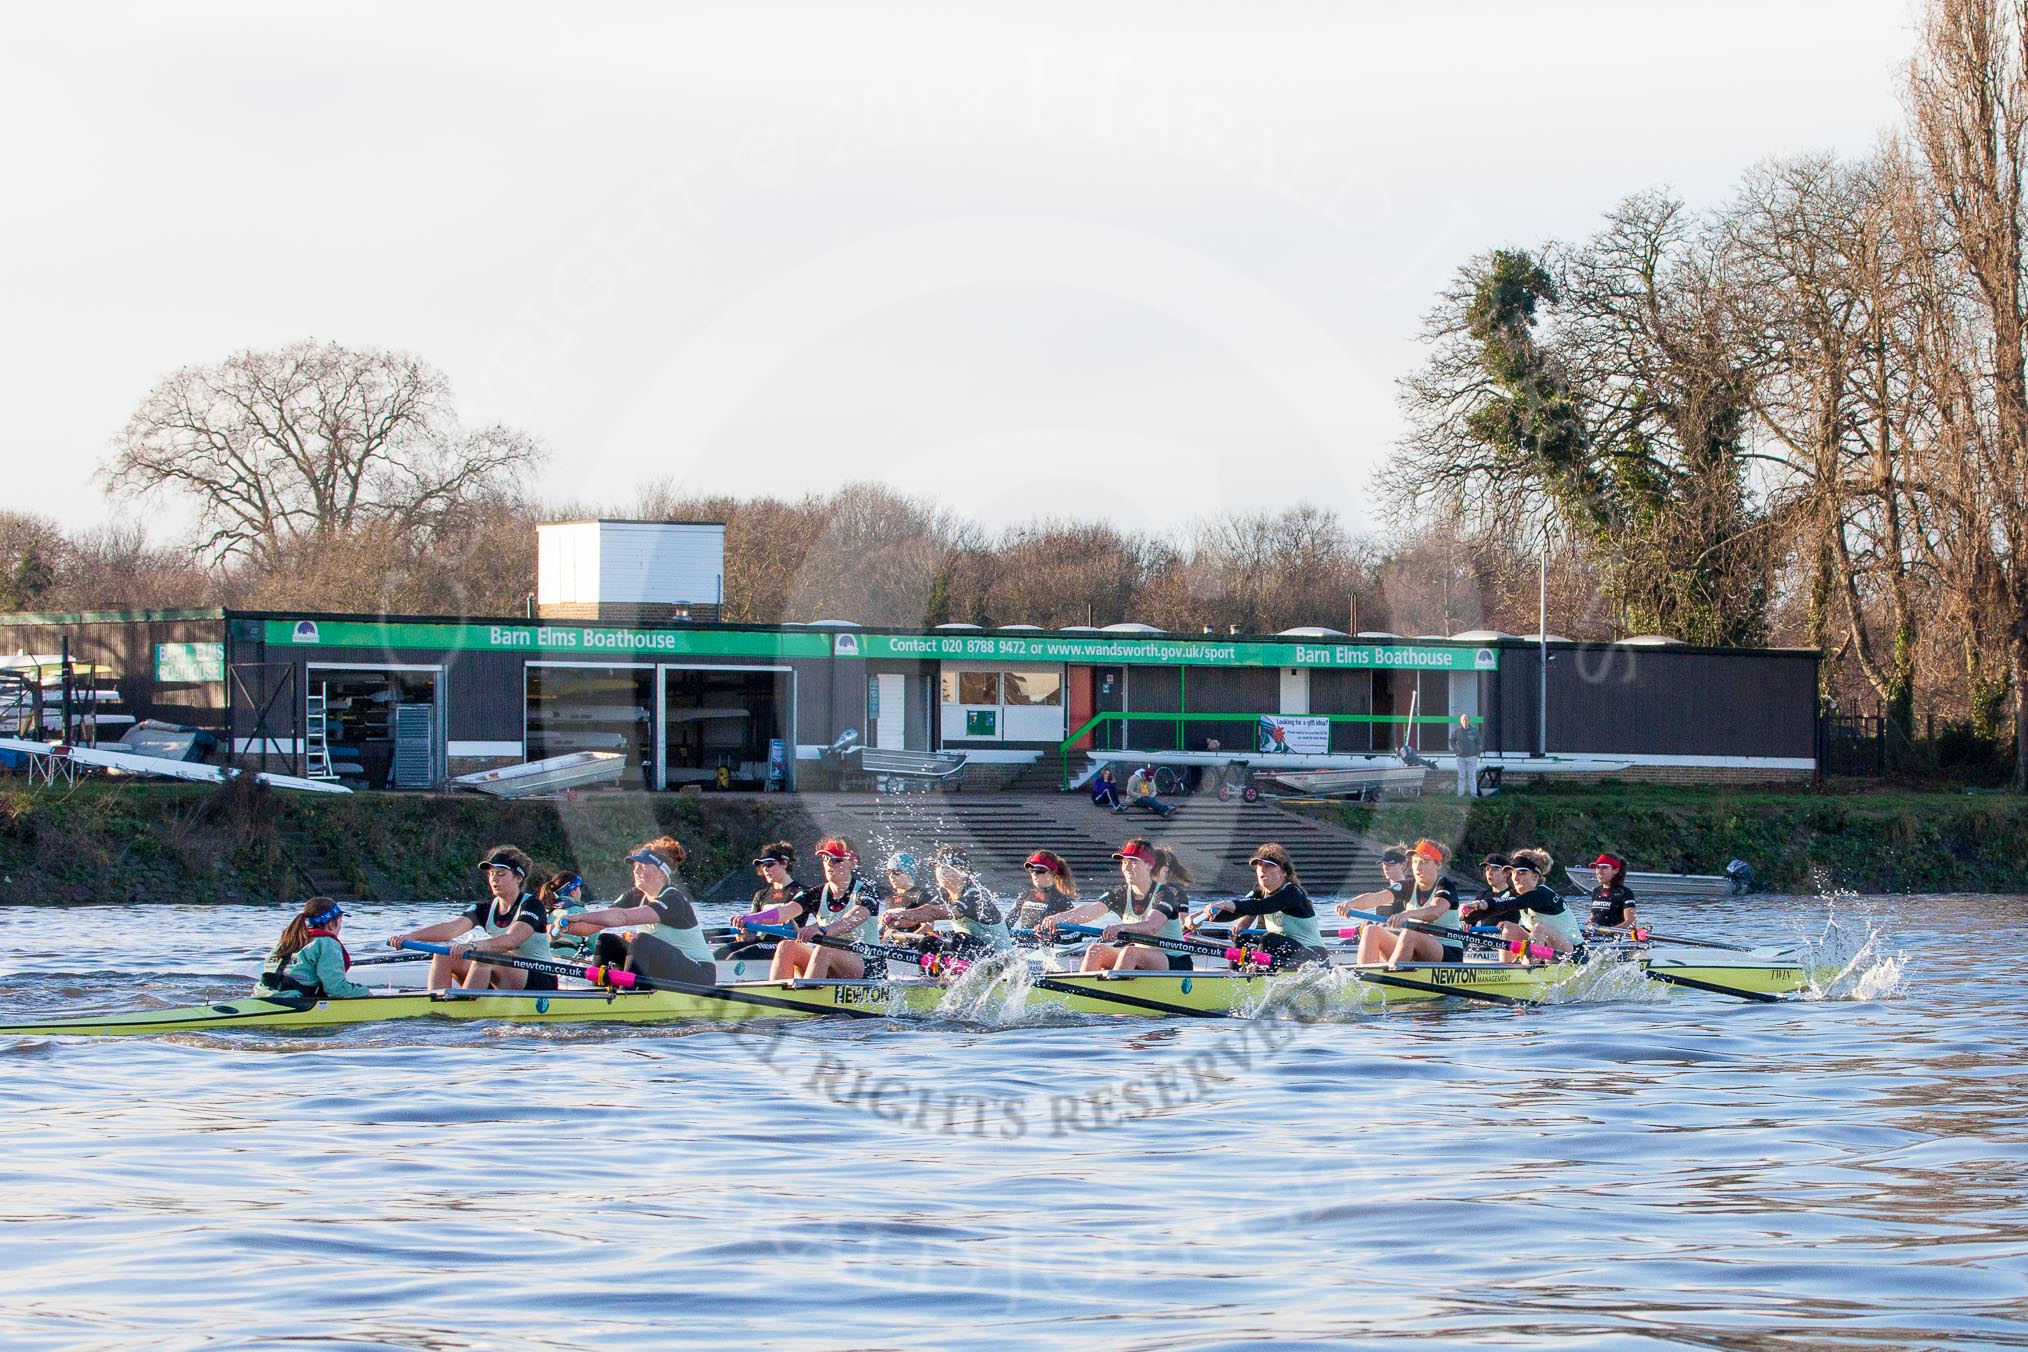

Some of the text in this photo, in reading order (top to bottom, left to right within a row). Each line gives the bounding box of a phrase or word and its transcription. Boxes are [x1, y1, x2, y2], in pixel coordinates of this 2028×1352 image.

[490, 626, 675, 649] Barn Elms Boathouse
[196, 643, 224, 661] ELMS
[889, 638, 1235, 662] Contact 020 8788 9472 or www.wandsworth.gov.uk/sport
[1296, 646, 1452, 666] Barn Elms Boathouse
[159, 663, 221, 681] BOATHOUSE
[1276, 719, 1295, 727] Looking
[1306, 719, 1315, 727] gift
[1159, 939, 1222, 957] newton.co.uk
[1446, 931, 1507, 949] newton.co.uk
[852, 943, 918, 963] newton.co.uk
[513, 959, 582, 977] newton.co.uk
[1431, 968, 1477, 984] NEWTON
[1477, 975, 1511, 983] MANAGEMENT
[834, 985, 890, 1004] NEWTON
